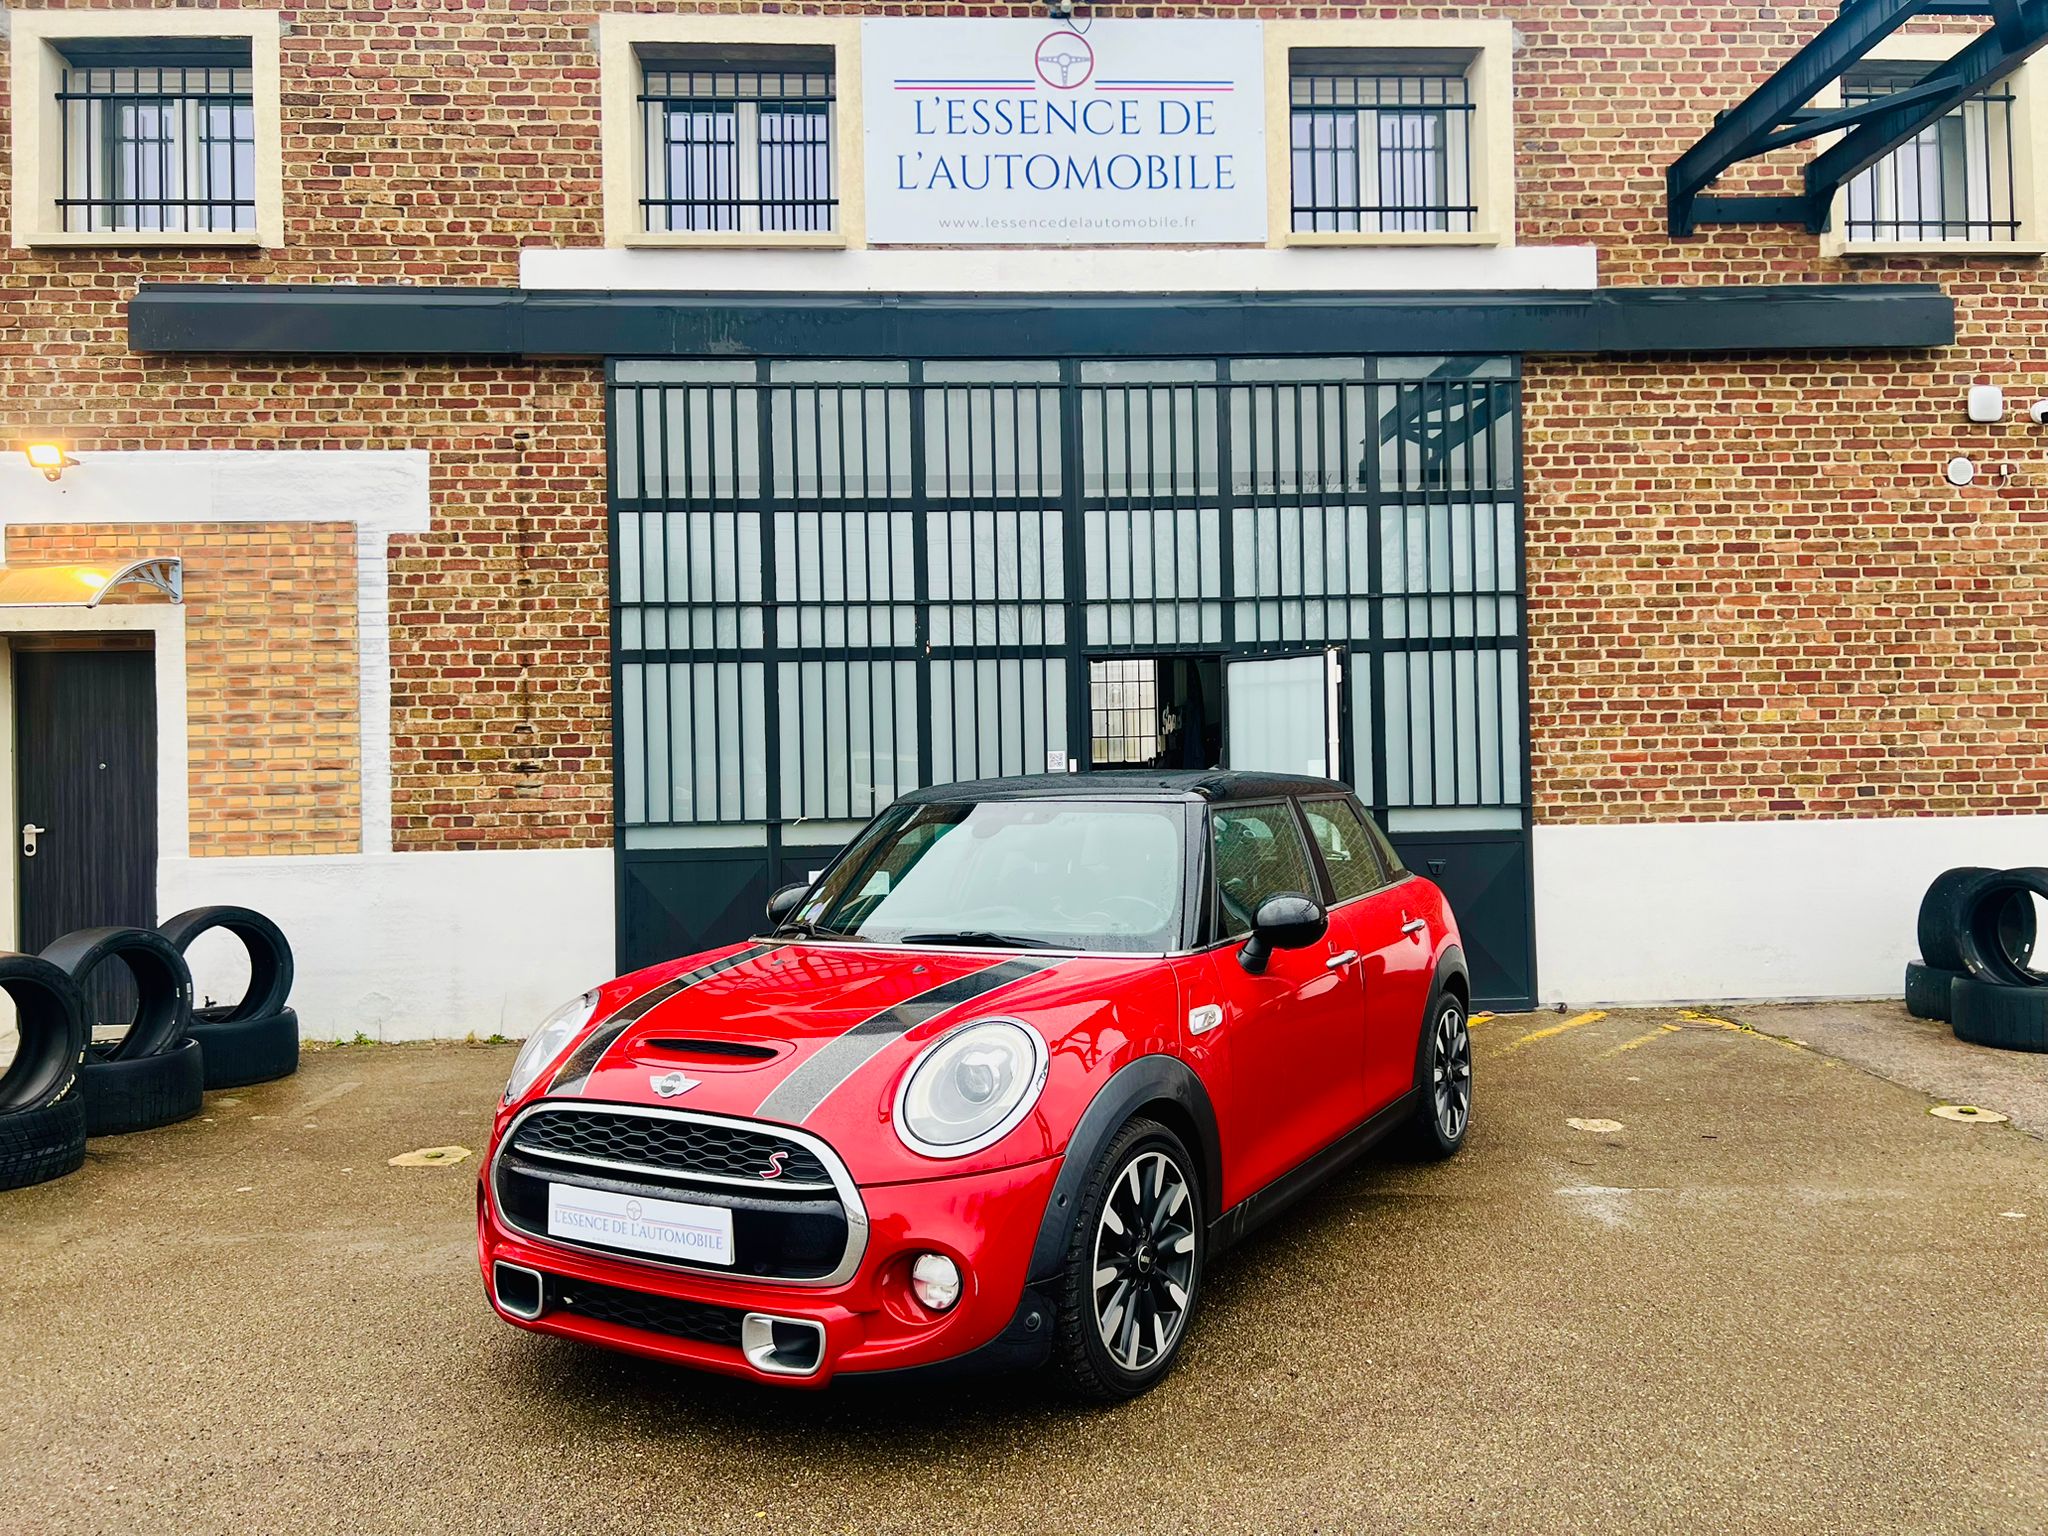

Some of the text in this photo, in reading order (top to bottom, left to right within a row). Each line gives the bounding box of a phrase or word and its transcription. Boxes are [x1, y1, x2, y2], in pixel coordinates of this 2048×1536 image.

[914, 96, 1217, 136] L'ESSENCE DE
[897, 151, 1237, 190] L'AUTOMOBILE
[938, 215, 1197, 230] www.lessencedelautomobile.fr
[759, 1151, 789, 1179] S
[554, 1209, 609, 1233] L'ESSENCE
[612, 1220, 628, 1235] DE
[631, 1223, 724, 1251] L'AUTOMOBILE
